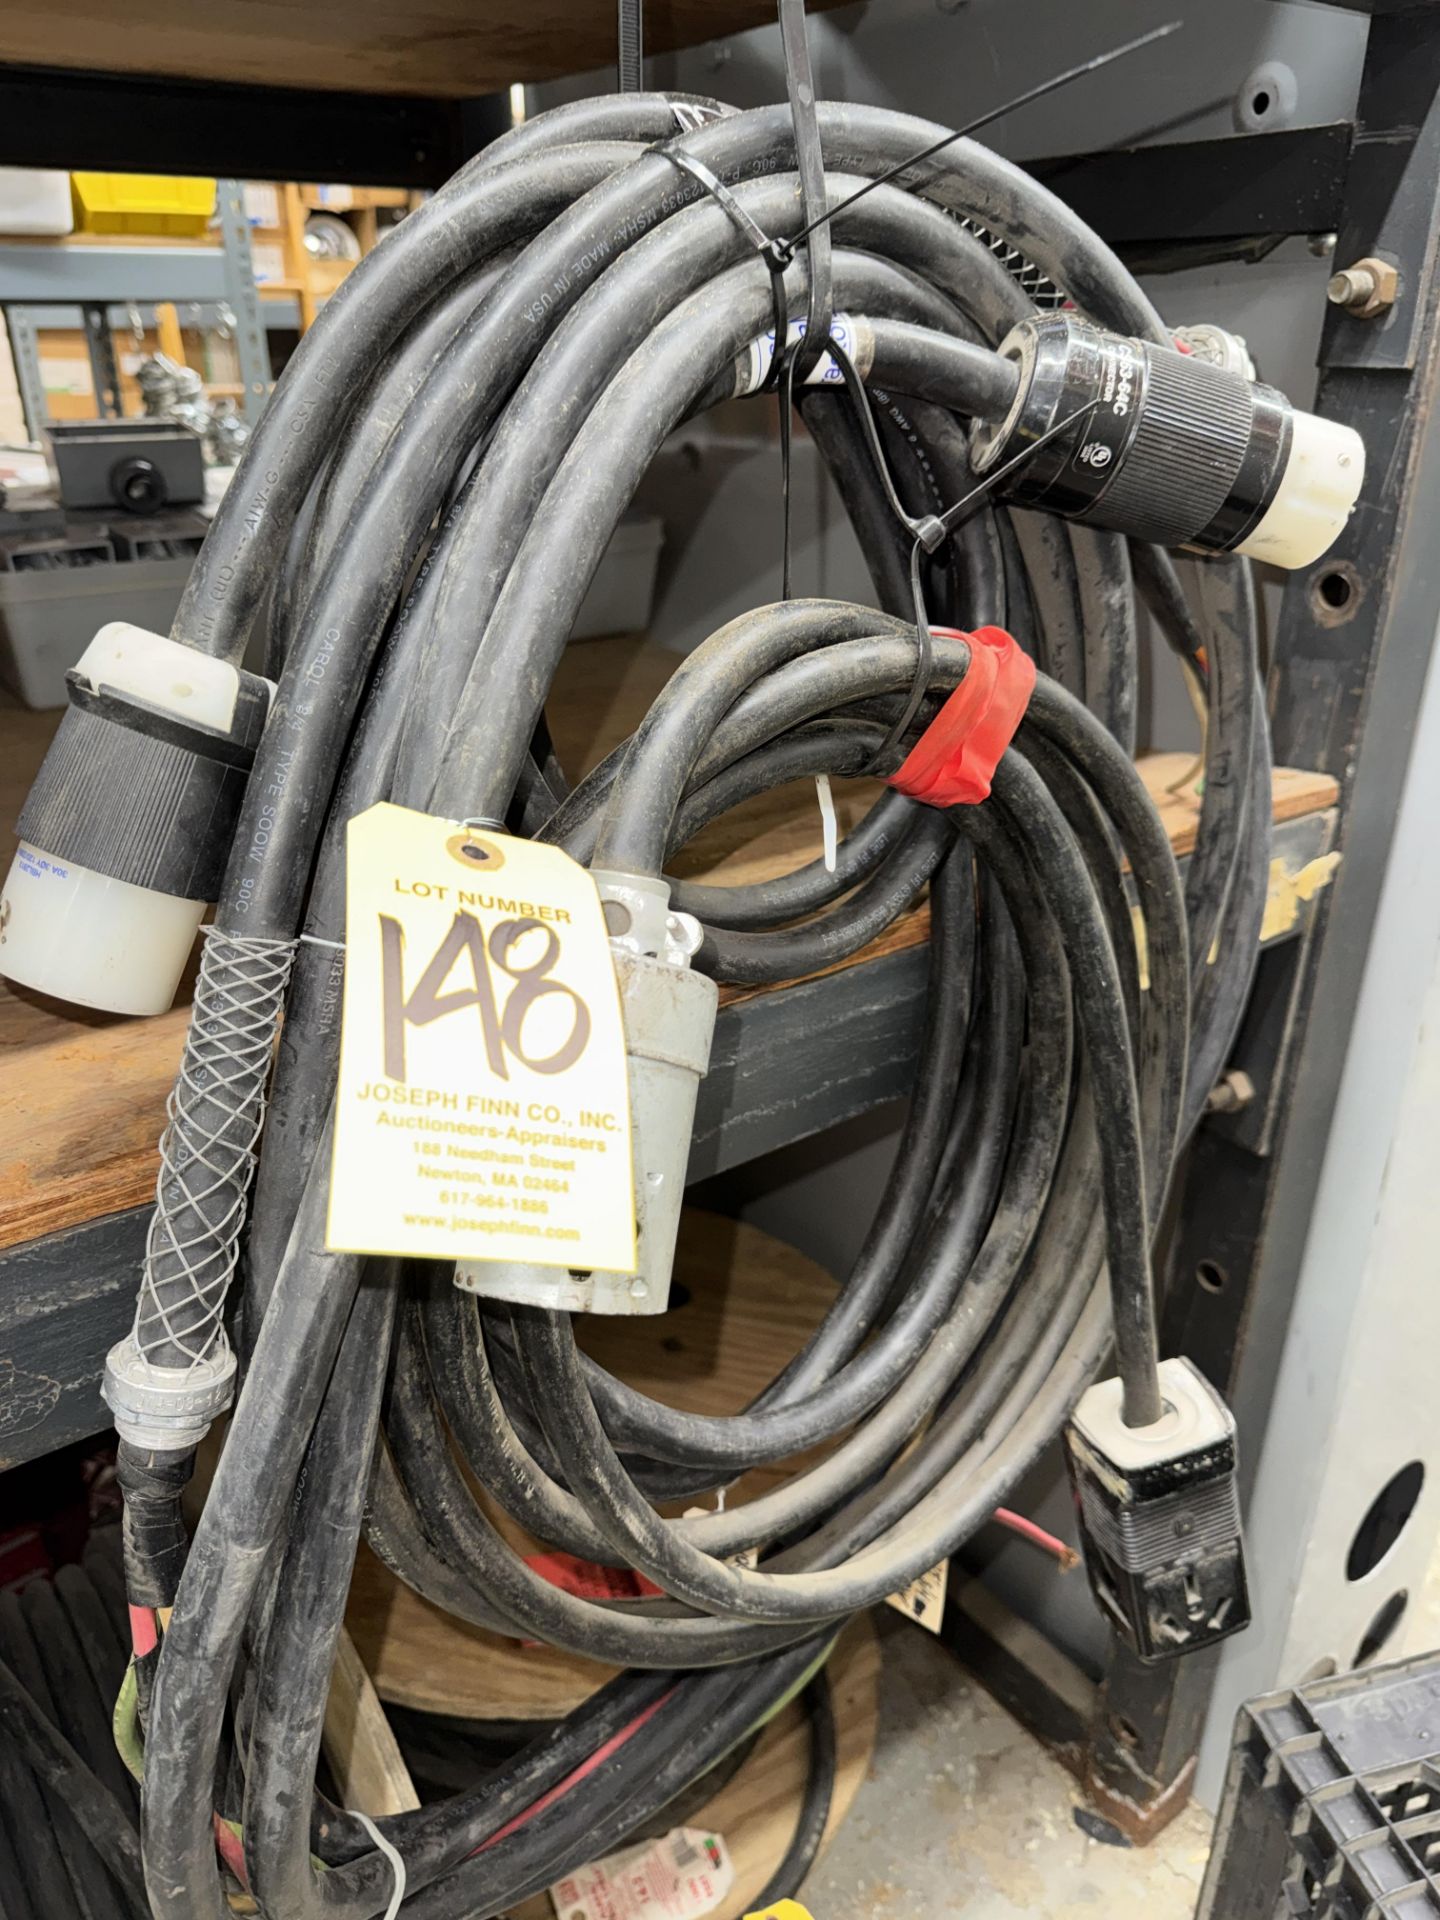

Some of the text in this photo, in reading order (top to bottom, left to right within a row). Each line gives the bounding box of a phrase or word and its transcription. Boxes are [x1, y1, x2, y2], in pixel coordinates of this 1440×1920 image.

[752, 156, 777, 175] 90C
[570, 240, 611, 279] MADE
[553, 273, 572, 296] IN
[523, 292, 554, 323] USA
[290, 397, 317, 436] CSA
[304, 627, 341, 687] CAROL
[290, 702, 314, 732] 8/4
[266, 749, 296, 800] TYPE
[249, 803, 277, 864] SOOW
[235, 877, 255, 914] 90C
[394, 878, 572, 924] LOT NUMBER
[316, 989, 341, 1037] MSHA
[378, 908, 592, 1084] 148
[357, 1082, 623, 1132] JOSEPH FINN CO., INC.
[376, 1110, 607, 1152] Auctioneers-Appraisers
[447, 1144, 525, 1165] Needham
[529, 1152, 576, 1172] Street
[417, 1163, 570, 1194] Newton, MA 02464
[403, 1212, 581, 1242] www.josephfinn.com
